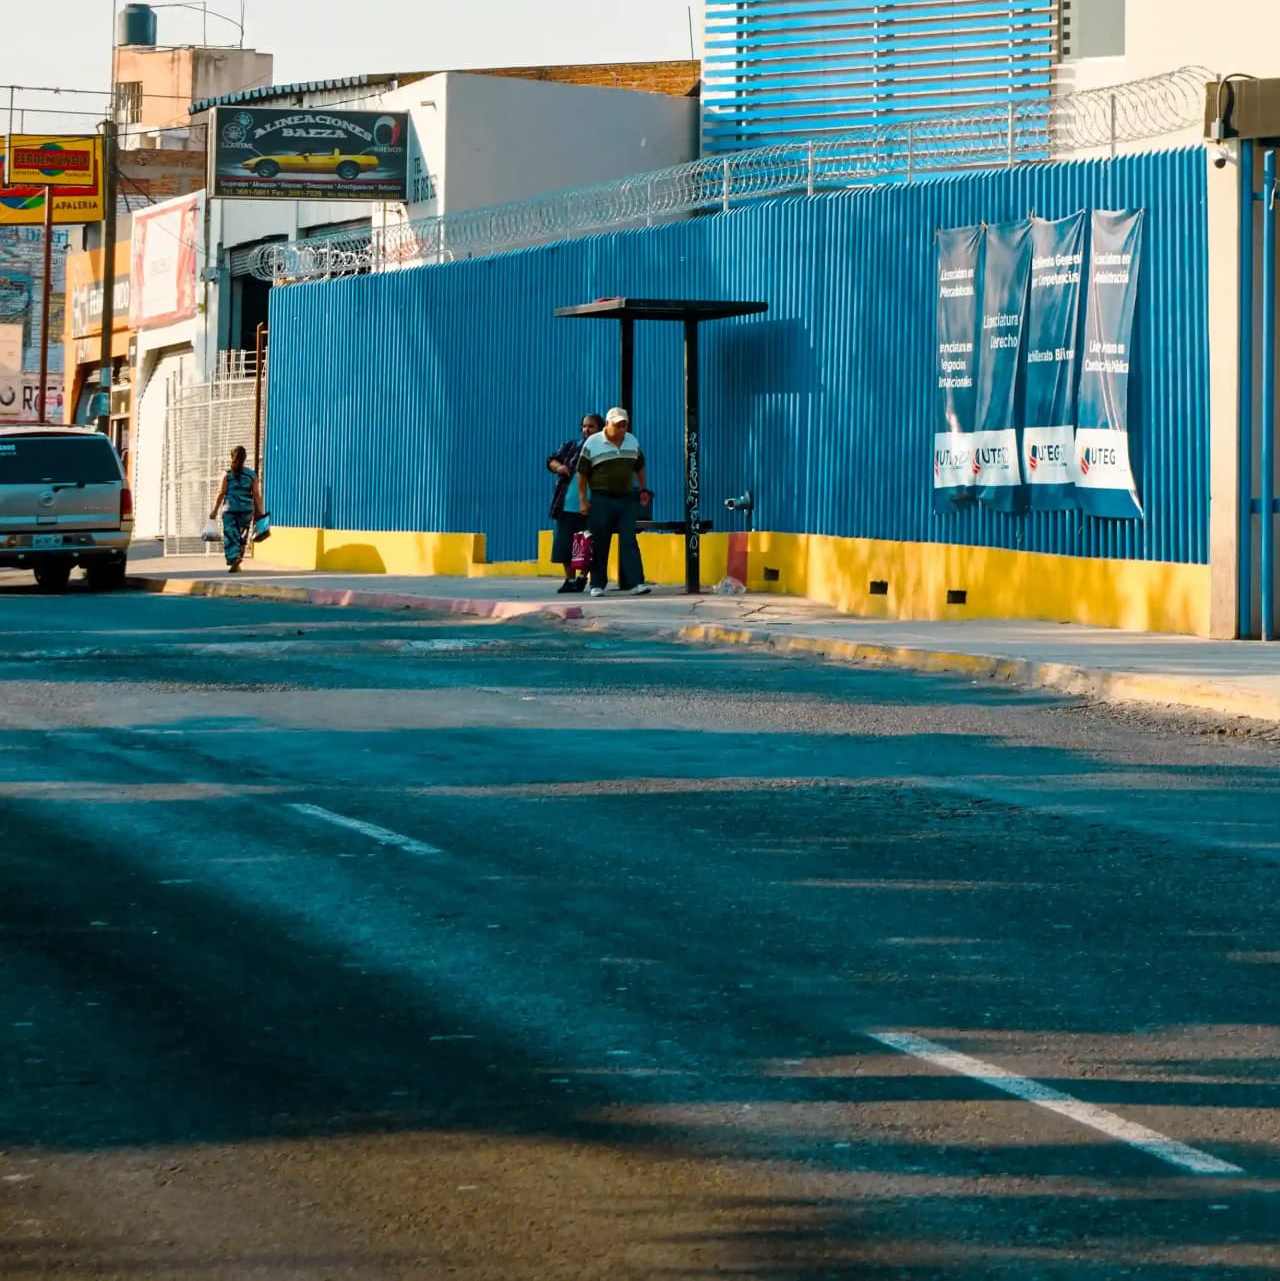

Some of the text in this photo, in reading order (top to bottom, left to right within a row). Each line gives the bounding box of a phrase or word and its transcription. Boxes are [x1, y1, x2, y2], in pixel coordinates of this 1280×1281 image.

[253, 114, 373, 142] ALINEACIONES
[281, 128, 348, 139] BAEZA
[1091, 447, 1116, 465] UTEG
